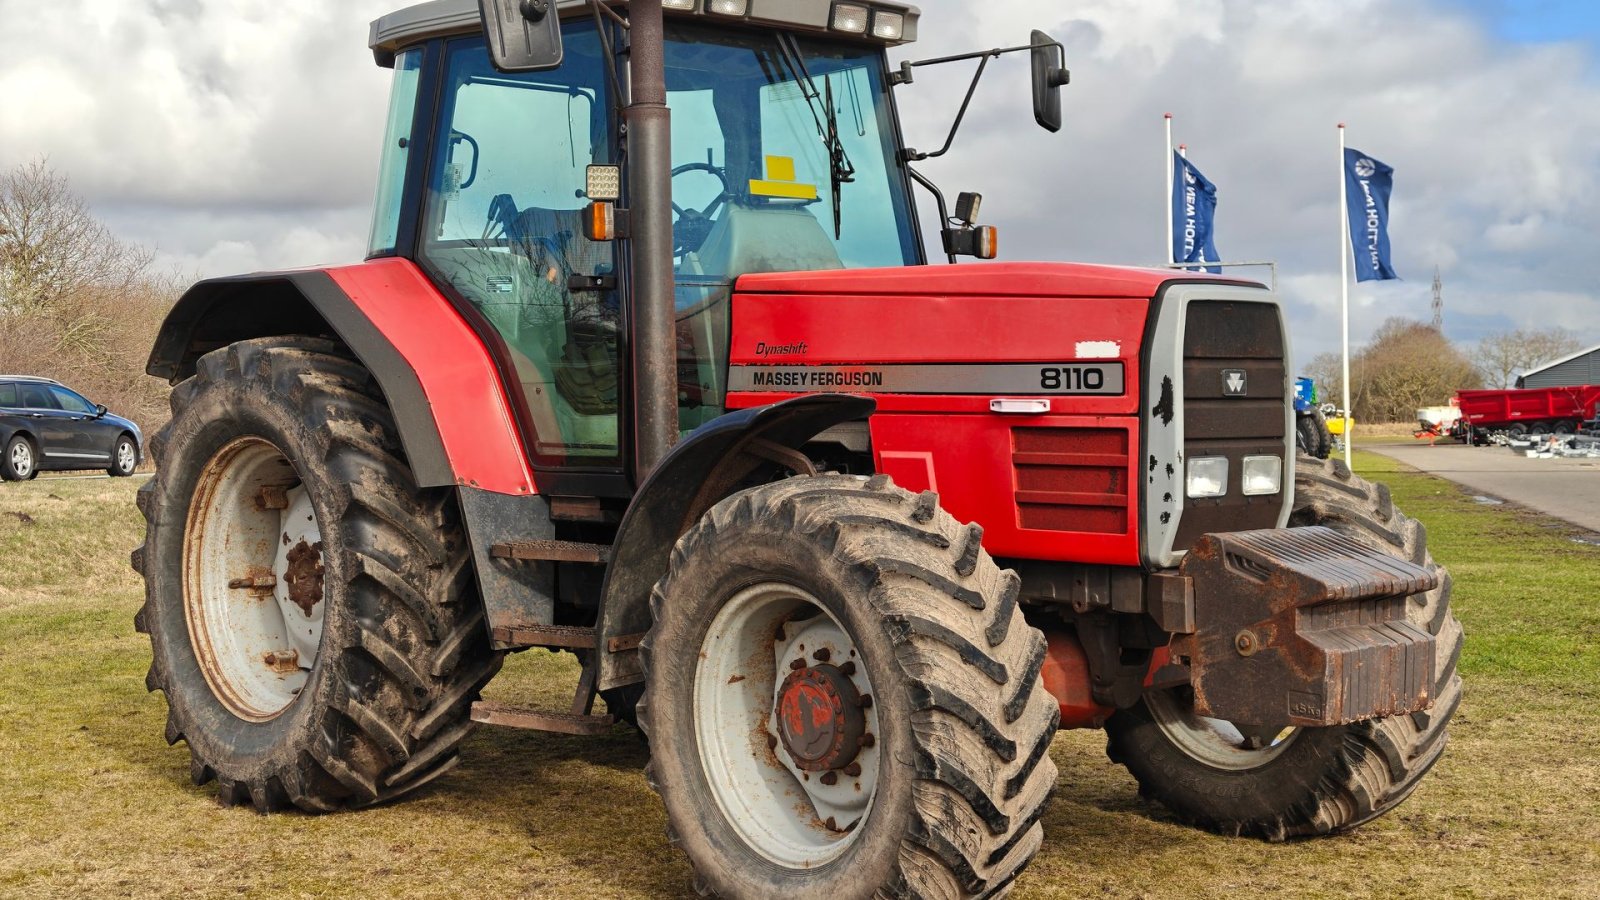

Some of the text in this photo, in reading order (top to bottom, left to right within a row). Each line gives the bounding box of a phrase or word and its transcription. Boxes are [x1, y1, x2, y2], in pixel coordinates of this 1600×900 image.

[755, 342, 808, 358] Dynashift
[753, 371, 882, 386] MASSEY FERGUSON
[1040, 367, 1104, 391] 8110
